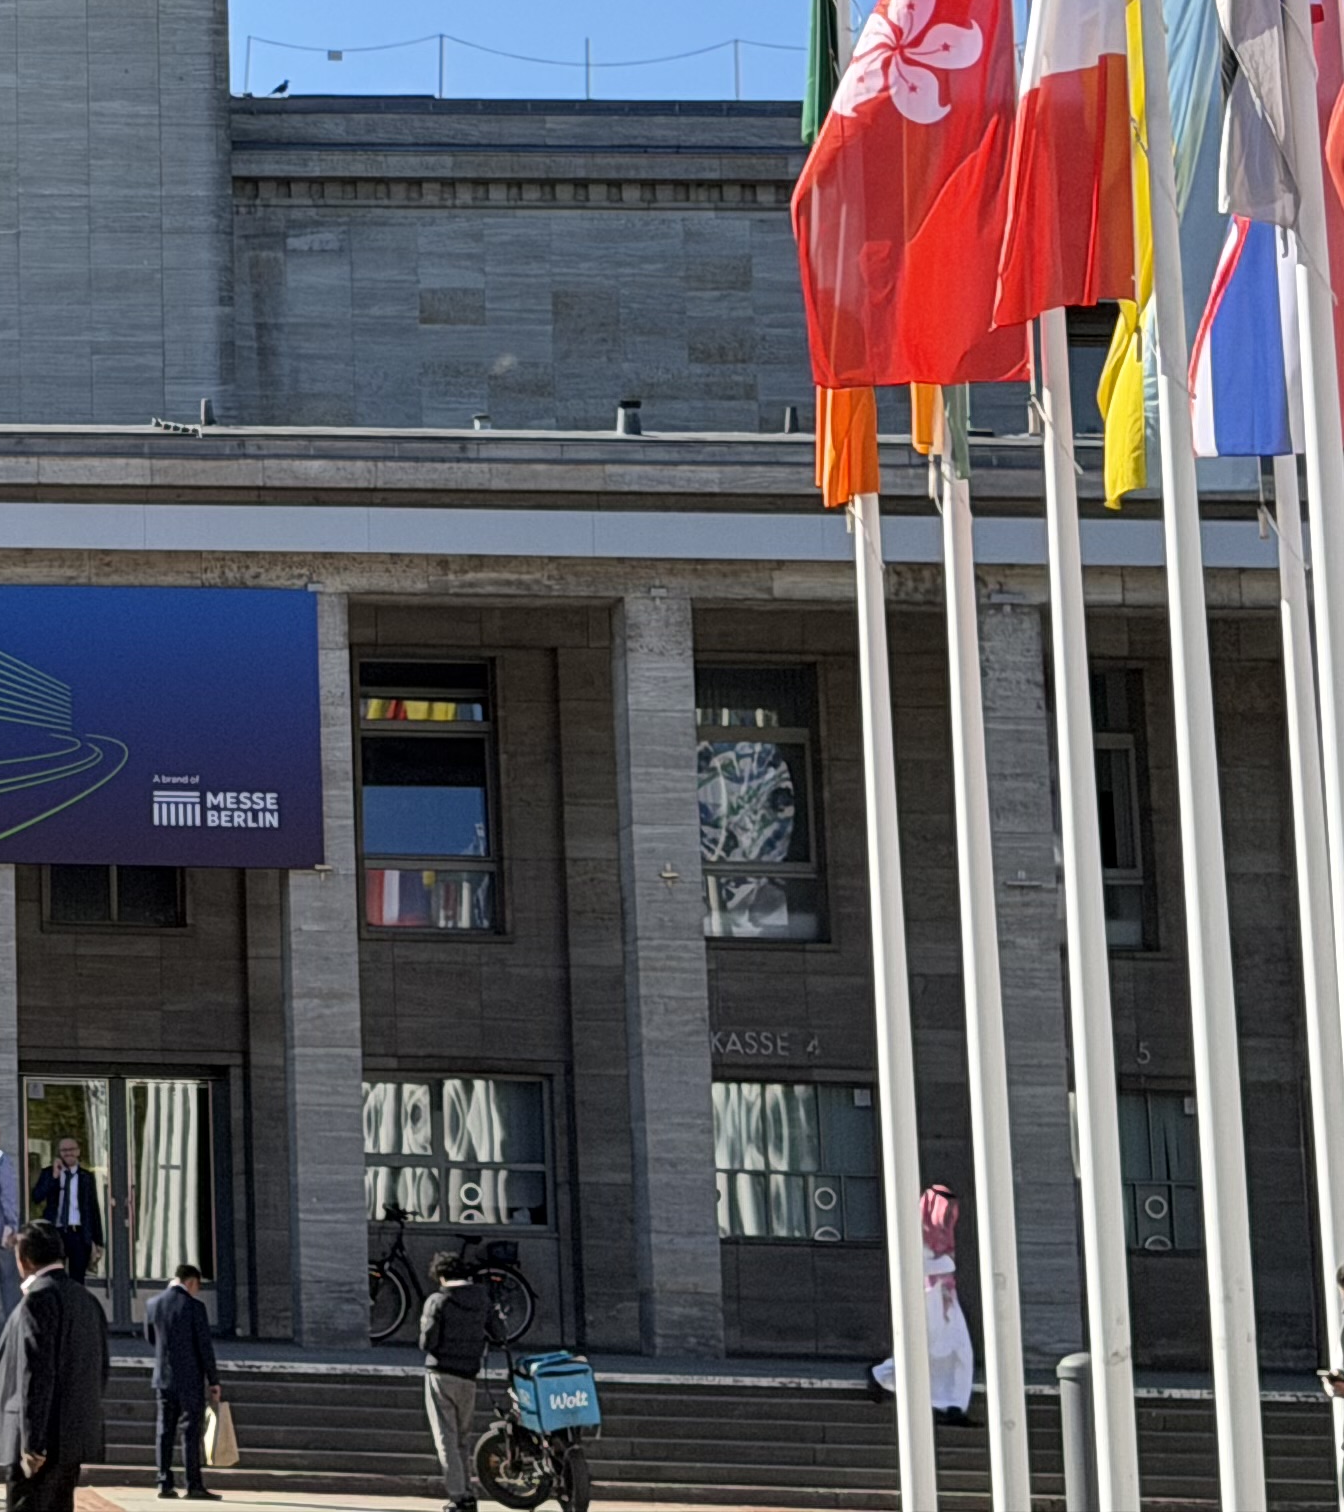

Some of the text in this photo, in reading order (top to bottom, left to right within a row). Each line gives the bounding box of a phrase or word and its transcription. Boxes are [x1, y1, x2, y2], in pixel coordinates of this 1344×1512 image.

[206, 791, 279, 809] MESSE
[206, 810, 279, 828] BERLIN
[711, 1031, 790, 1056] KASSE
[1136, 1041, 1151, 1065] 5
[549, 1390, 589, 1410] Wolt
